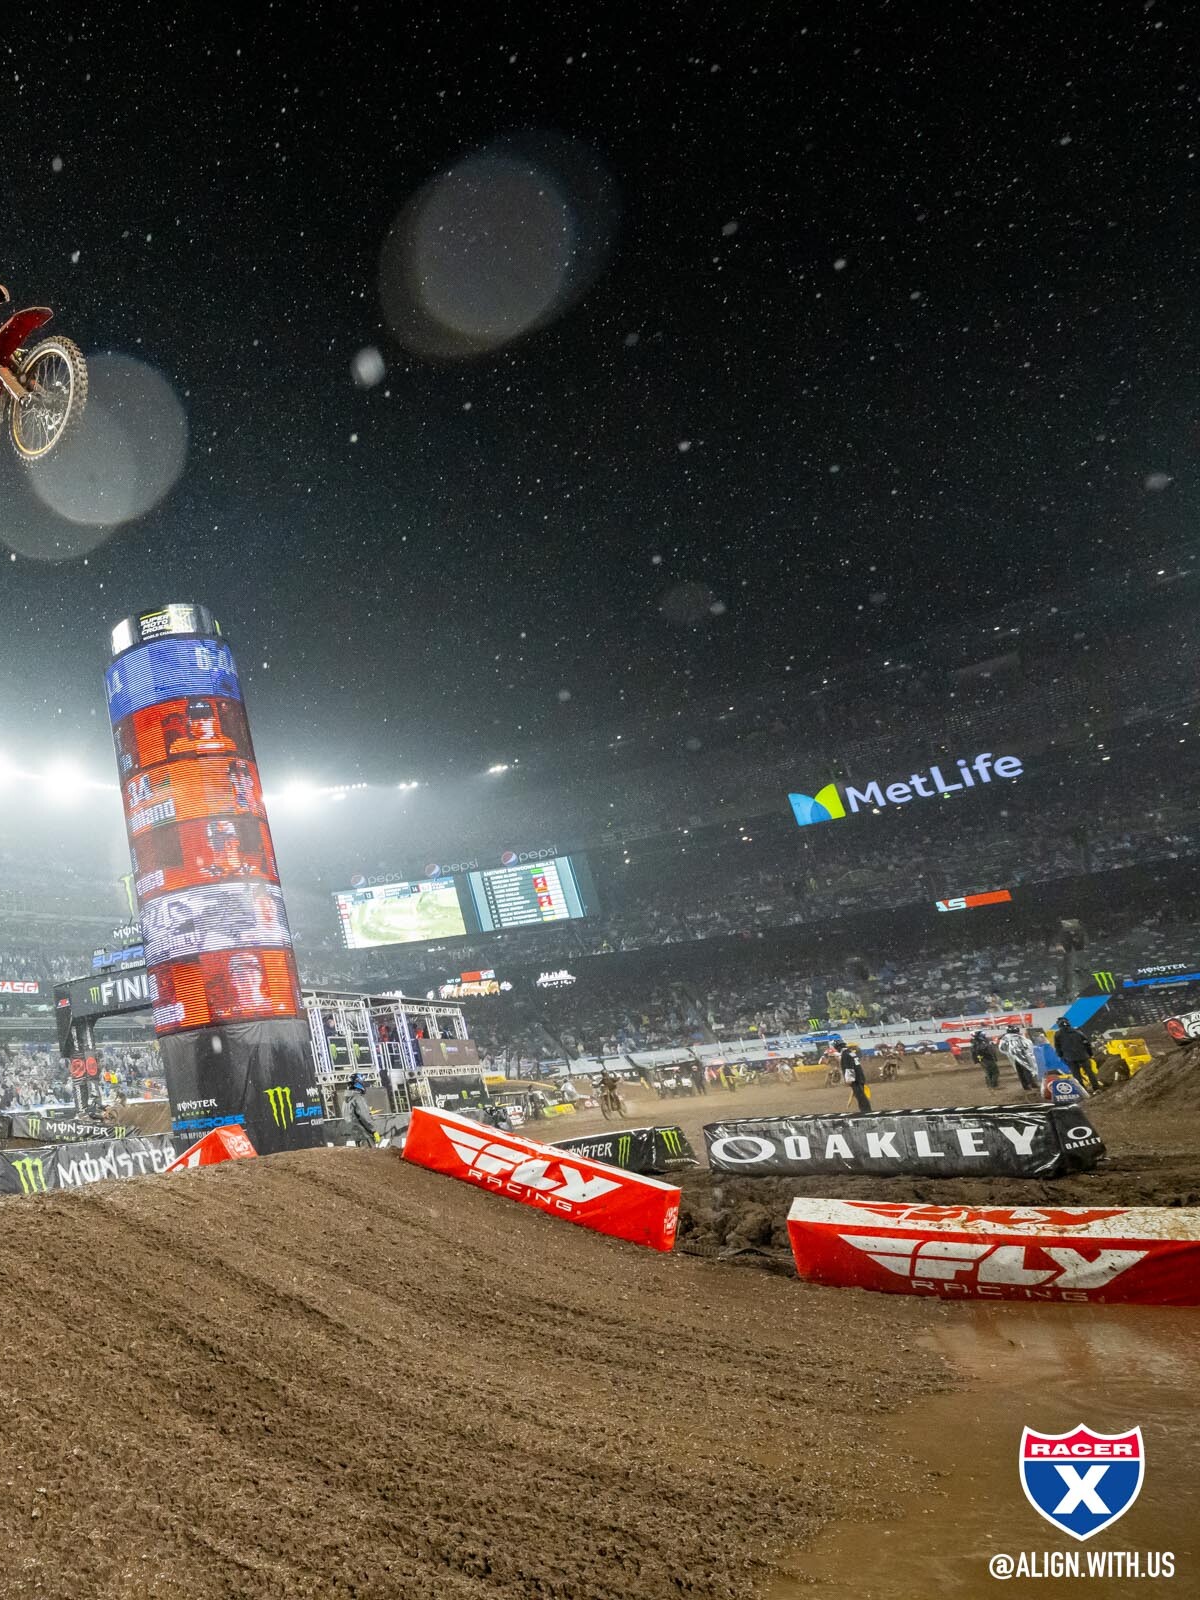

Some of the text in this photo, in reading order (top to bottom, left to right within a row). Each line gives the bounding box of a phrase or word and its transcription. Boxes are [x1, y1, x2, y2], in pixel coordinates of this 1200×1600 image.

[845, 752, 1024, 813] MetLife
[441, 858, 479, 876] pepsi
[518, 846, 558, 864] pepsi
[367, 871, 403, 887] pepsi
[100, 974, 149, 1006] FINI
[177, 1098, 219, 1112] MONSTER
[46, 1121, 109, 1137] MONSTER
[785, 1125, 1044, 1160] OAKLEY
[1065, 1136, 1102, 1150] OAKLEY
[57, 1146, 178, 1189] MONSTER
[440, 1124, 624, 1203] FLY
[467, 1168, 573, 1213] RACING
[836, 1233, 1151, 1291] FLY
